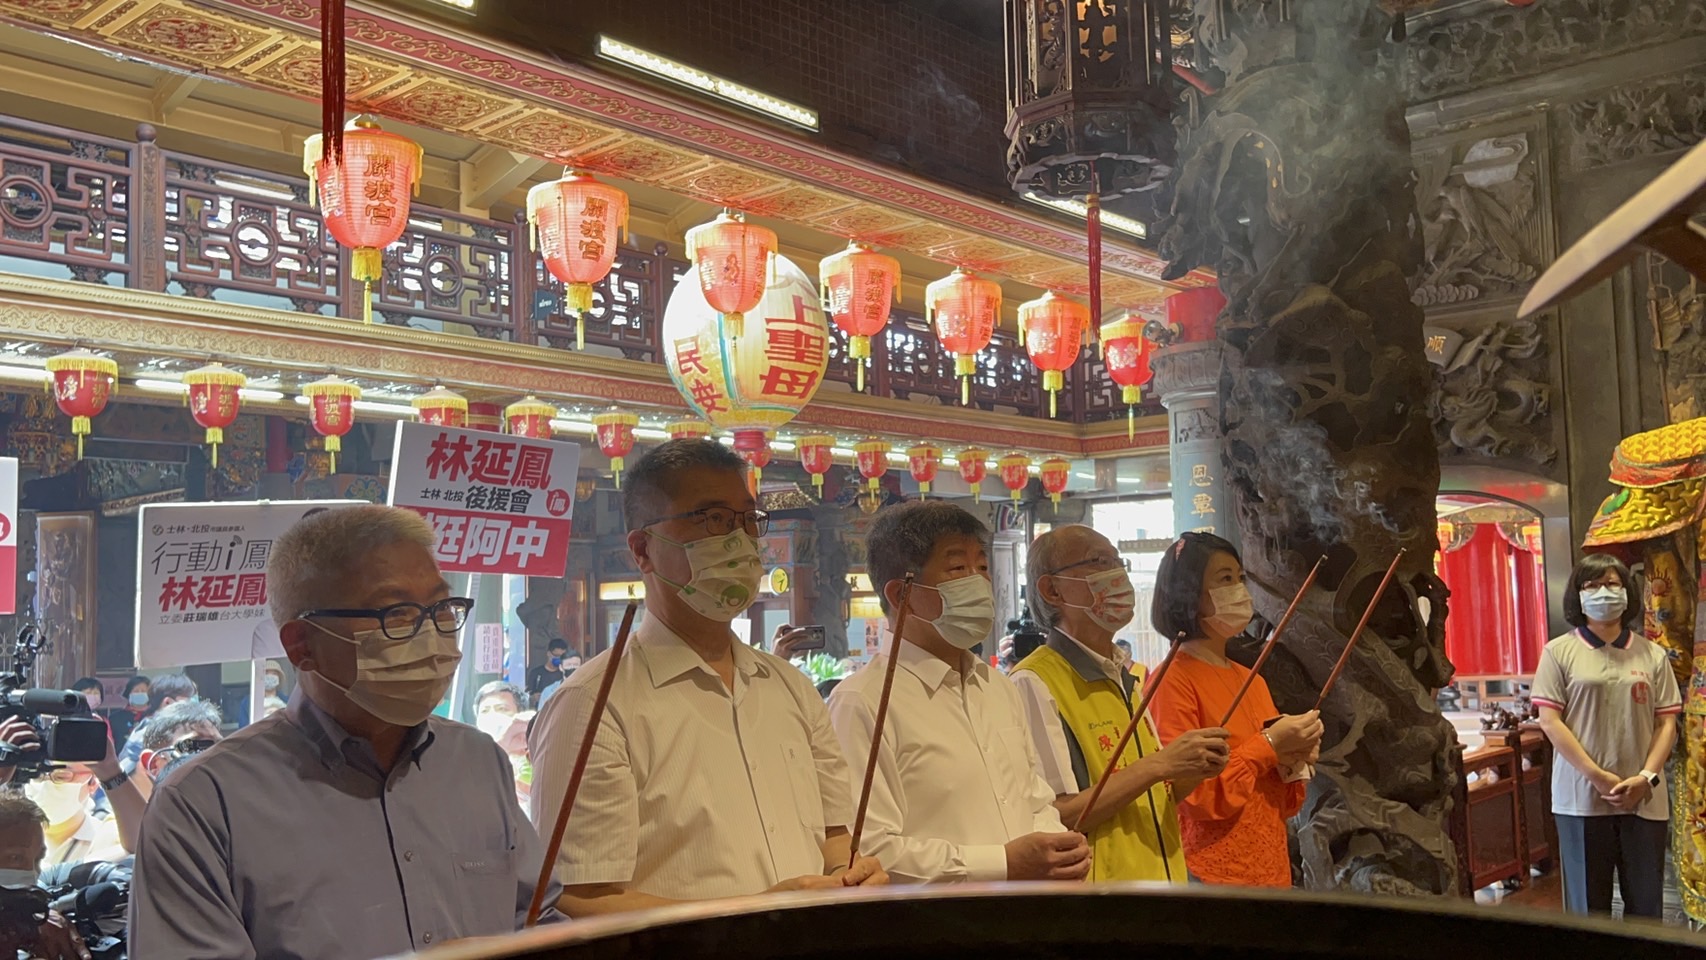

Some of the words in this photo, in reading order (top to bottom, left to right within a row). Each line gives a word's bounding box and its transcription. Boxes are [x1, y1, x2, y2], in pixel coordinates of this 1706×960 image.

[363, 154, 396, 227] 關渡宮
[579, 197, 609, 262] 關渡宮
[674, 334, 728, 414] 民安
[426, 432, 554, 490] 林延鳳
[465, 485, 532, 514] 後援會
[158, 573, 268, 612] 林延鳳
